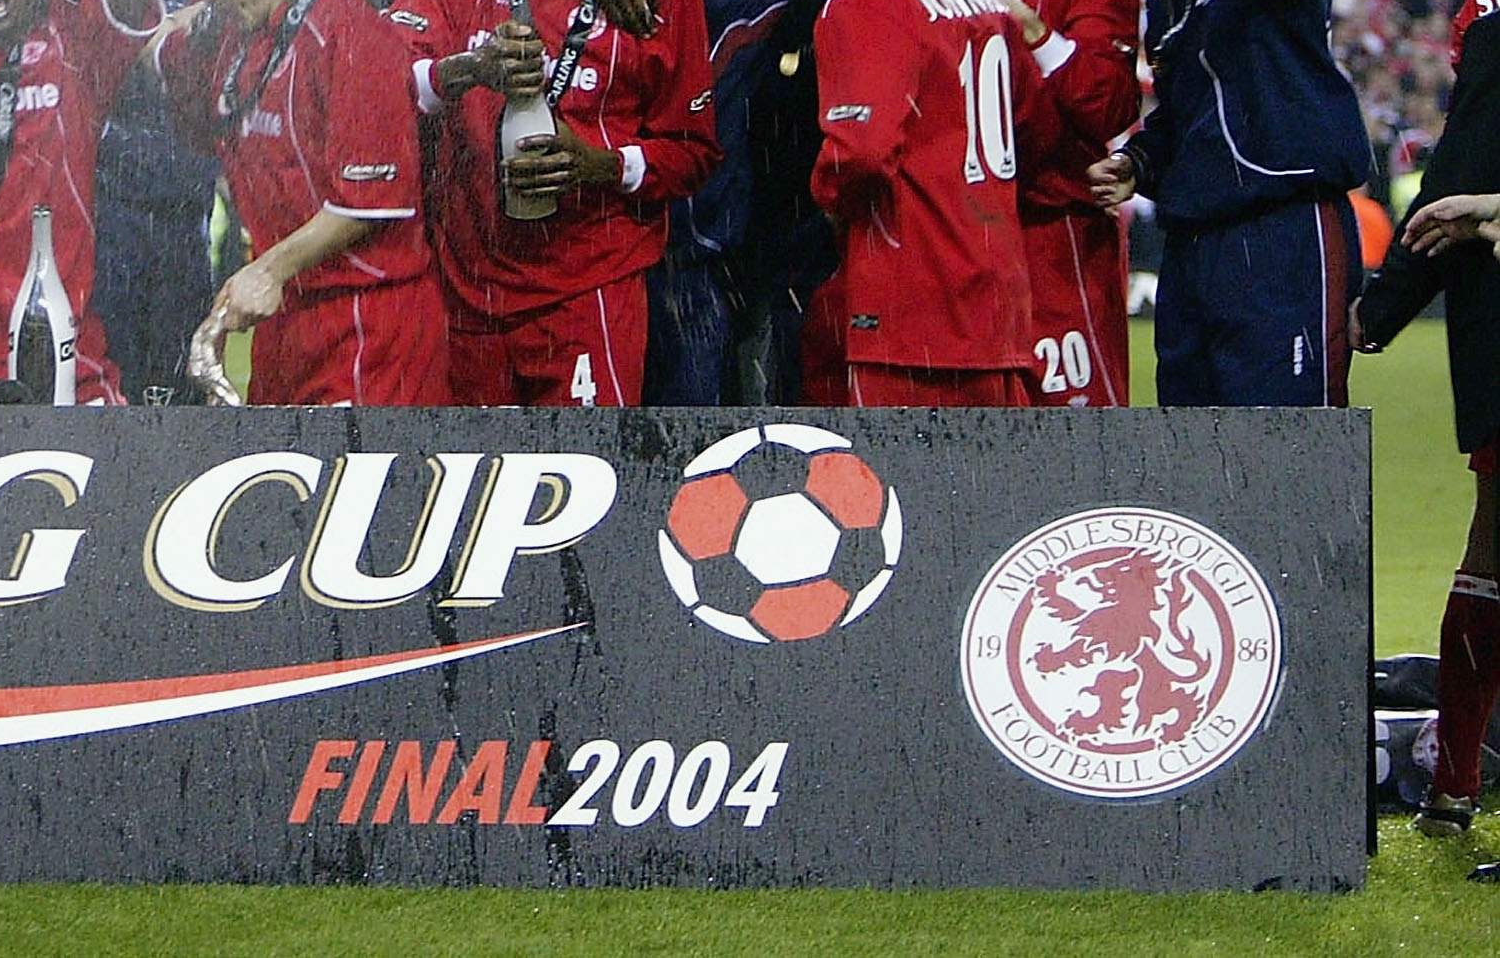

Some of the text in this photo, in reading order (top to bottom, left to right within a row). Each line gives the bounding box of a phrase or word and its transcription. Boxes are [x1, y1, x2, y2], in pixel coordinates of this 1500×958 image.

[546, 47, 577, 107] CARLING
[958, 34, 1016, 184] 10
[570, 352, 597, 408] 4
[1034, 330, 1093, 393] 20
[143, 452, 619, 612] CUP
[996, 518, 1254, 602] MIDDLESBROUGH
[975, 634, 1269, 663] 19 86
[991, 702, 1238, 784] FOOTBALL CLUB
